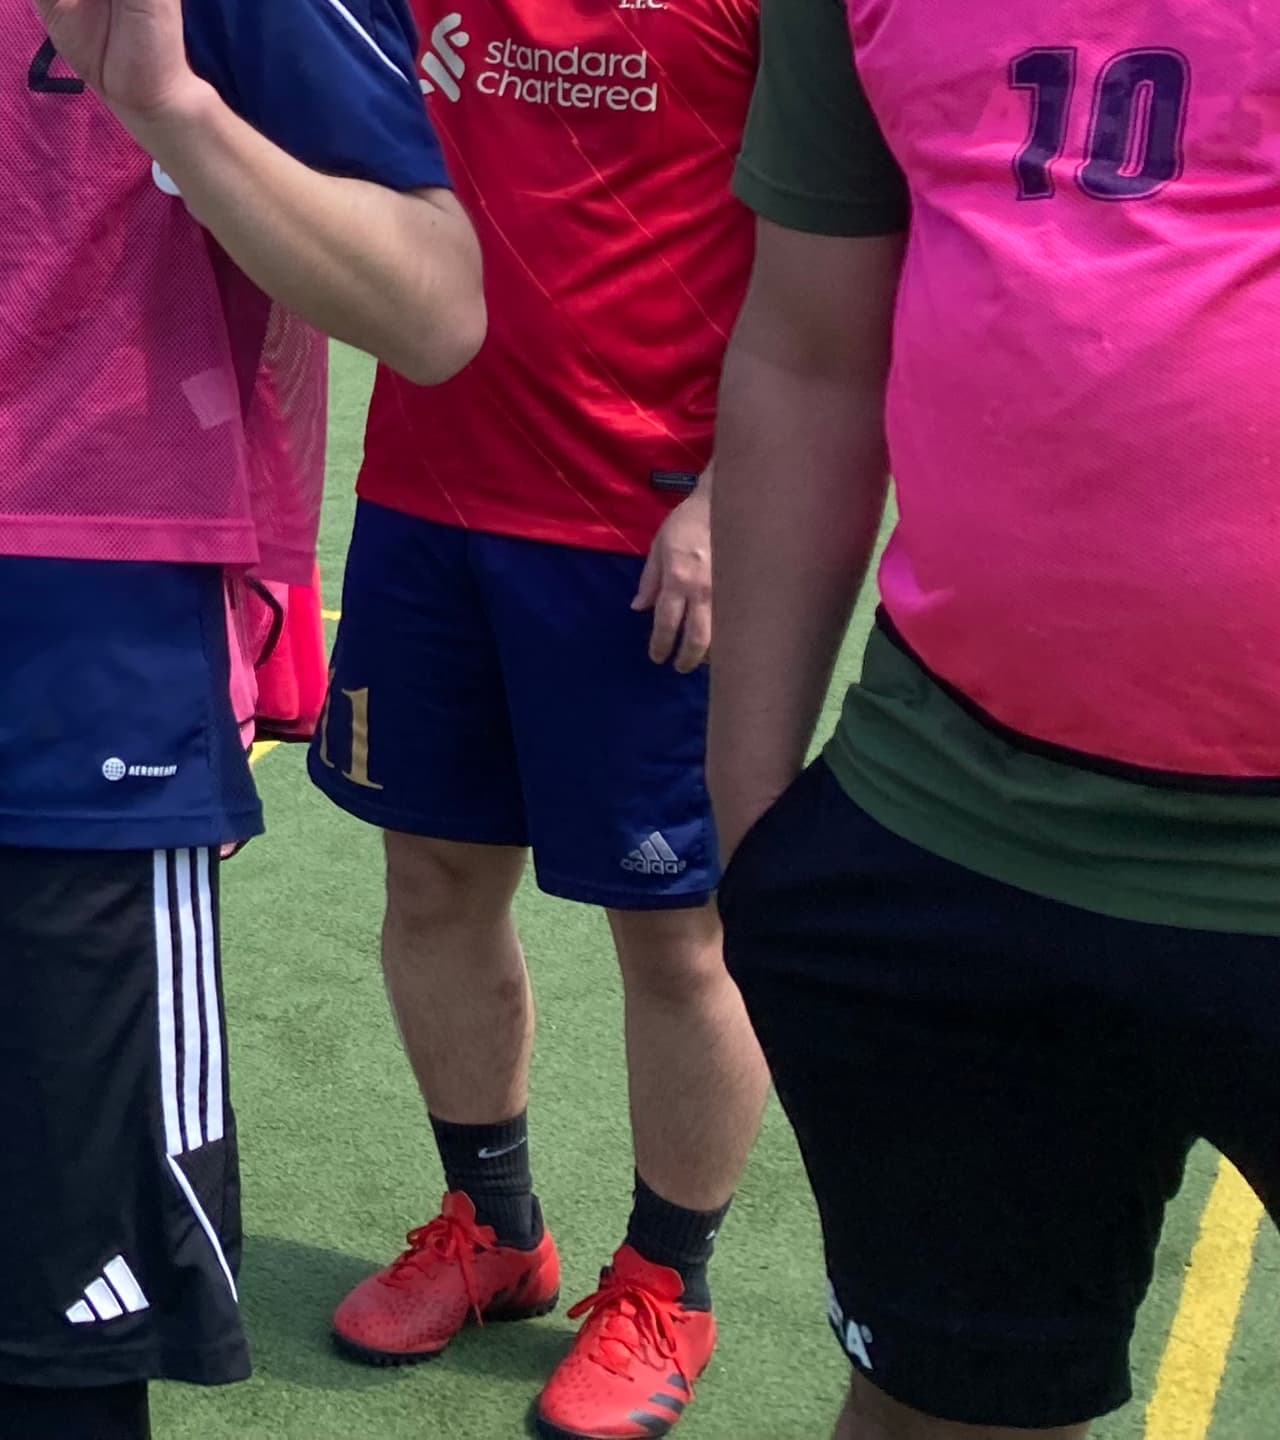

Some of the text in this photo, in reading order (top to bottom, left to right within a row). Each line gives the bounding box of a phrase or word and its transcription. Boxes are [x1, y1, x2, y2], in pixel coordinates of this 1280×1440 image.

[484, 38, 647, 79] standard
[476, 70, 658, 112] chartered
[1008, 46, 1191, 202] 10
